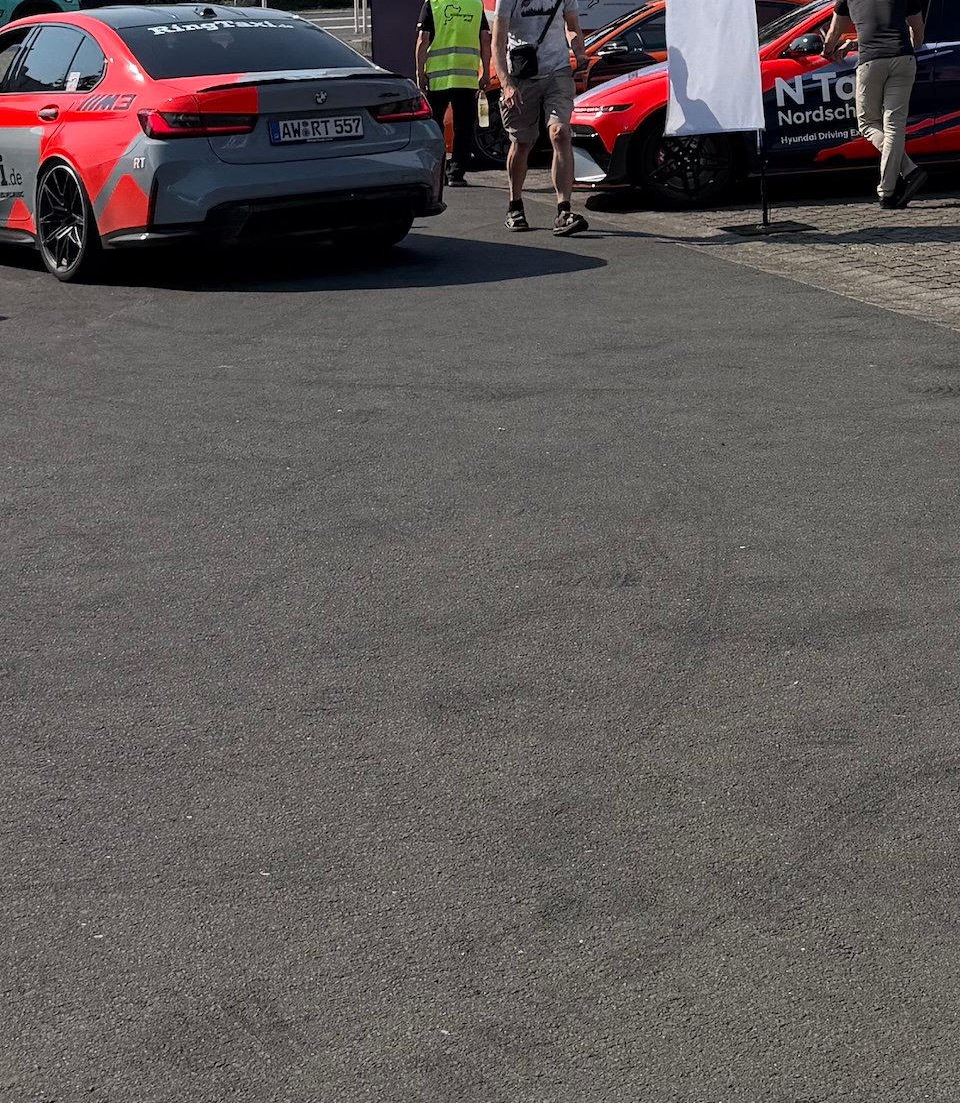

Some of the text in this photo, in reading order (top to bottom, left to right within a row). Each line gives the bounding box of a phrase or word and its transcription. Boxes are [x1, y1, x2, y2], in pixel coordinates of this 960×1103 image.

[775, 71, 856, 107] N Ta
[778, 103, 858, 126] Nordsch
[334, 118, 361, 135] 557
[780, 132, 817, 145] Hyundai
[818, 129, 849, 139] Driving
[133, 157, 146, 169] RT
